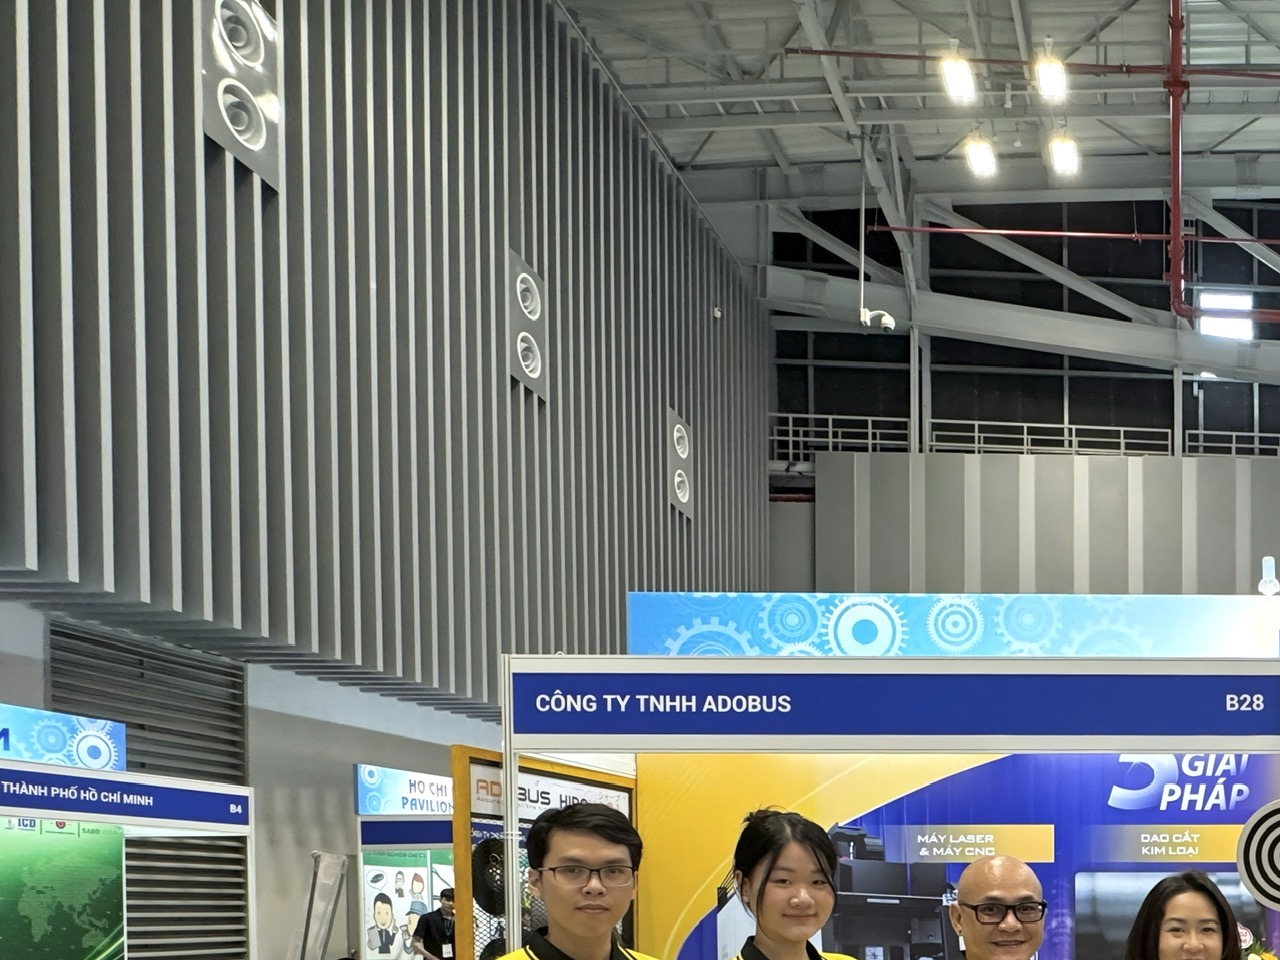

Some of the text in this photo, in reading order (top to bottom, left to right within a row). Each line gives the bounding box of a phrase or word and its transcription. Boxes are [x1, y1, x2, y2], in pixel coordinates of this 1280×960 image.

[535, 689, 792, 713] CÔNG TY TNHH ADOBUS
[1225, 694, 1265, 711] B28
[1, 780, 153, 806] THÀNH PHỐ HỒ CHÍ MINH
[409, 779, 447, 797] HO CHI
[476, 778, 551, 806] ADBUS
[1159, 777, 1250, 811] PHÁP
[229, 803, 243, 814] B4
[917, 832, 994, 843] MÁY LASER
[1140, 830, 1201, 843] DAO CẮT
[919, 845, 996, 856] & MÁY CNC
[1141, 846, 1199, 858] KIM LOẠI
